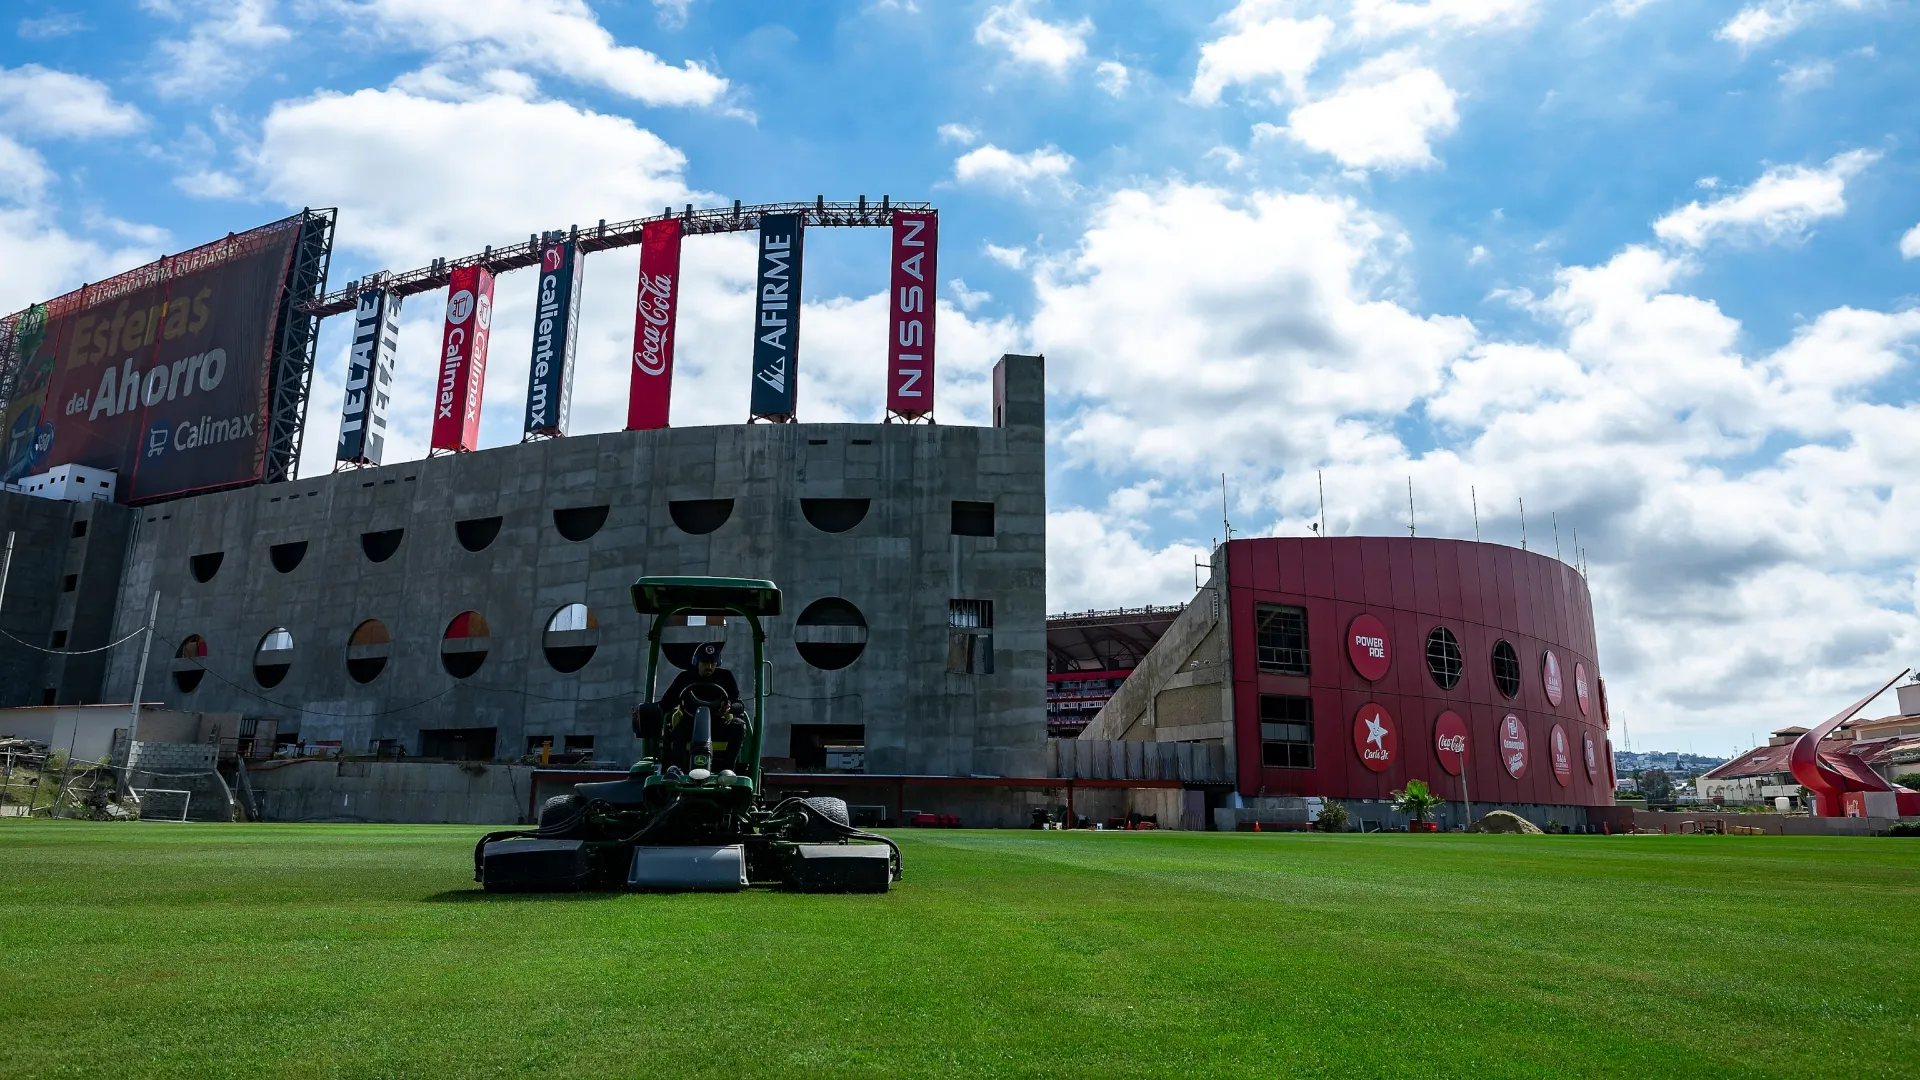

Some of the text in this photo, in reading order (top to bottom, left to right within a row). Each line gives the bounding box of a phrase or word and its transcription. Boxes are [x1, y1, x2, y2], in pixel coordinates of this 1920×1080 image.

[66, 287, 212, 371] Esferas
[635, 270, 672, 376] Coca-Cola
[760, 233, 791, 350] AFIRME
[898, 219, 925, 397] NISSAN
[65, 348, 227, 422] del Ahorro
[338, 294, 380, 446] TECATE
[364, 294, 400, 449] TECATE
[438, 326, 465, 420] Calimax
[467, 330, 485, 424] Calimax
[531, 274, 558, 427] caliente.mx
[173, 412, 256, 451] Calimax
[1355, 635, 1383, 648] POWER
[1369, 647, 1385, 658] ADE
[1438, 733, 1465, 753] Coca-Cola
